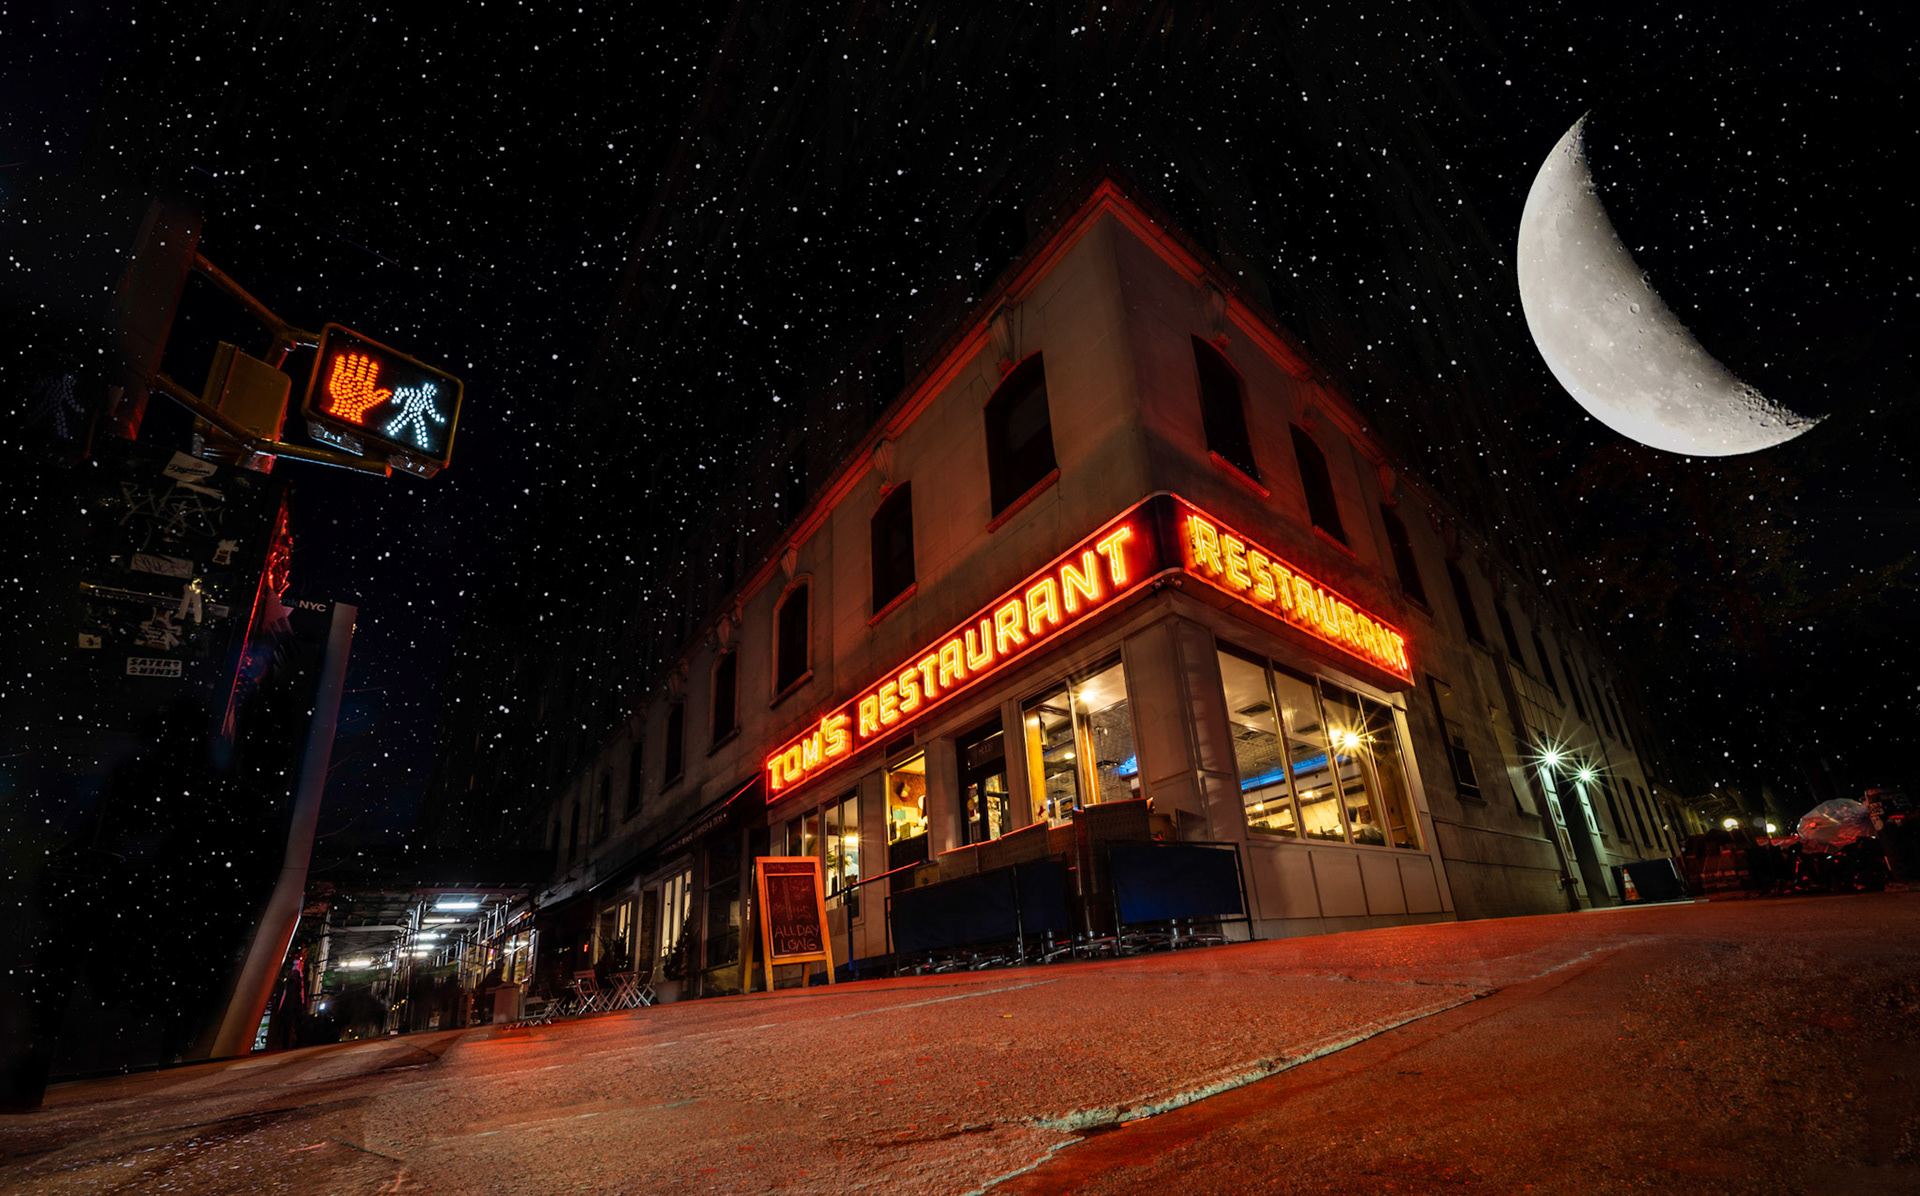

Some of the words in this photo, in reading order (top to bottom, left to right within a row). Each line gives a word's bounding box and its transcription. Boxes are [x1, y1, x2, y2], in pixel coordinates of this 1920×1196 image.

[1187, 515, 1408, 671] RESTAURANT
[130, 658, 171, 667] SATER
[767, 714, 852, 790] TOM'S
[859, 527, 1131, 737] RESTAURANT
[781, 938, 817, 952] LONG
